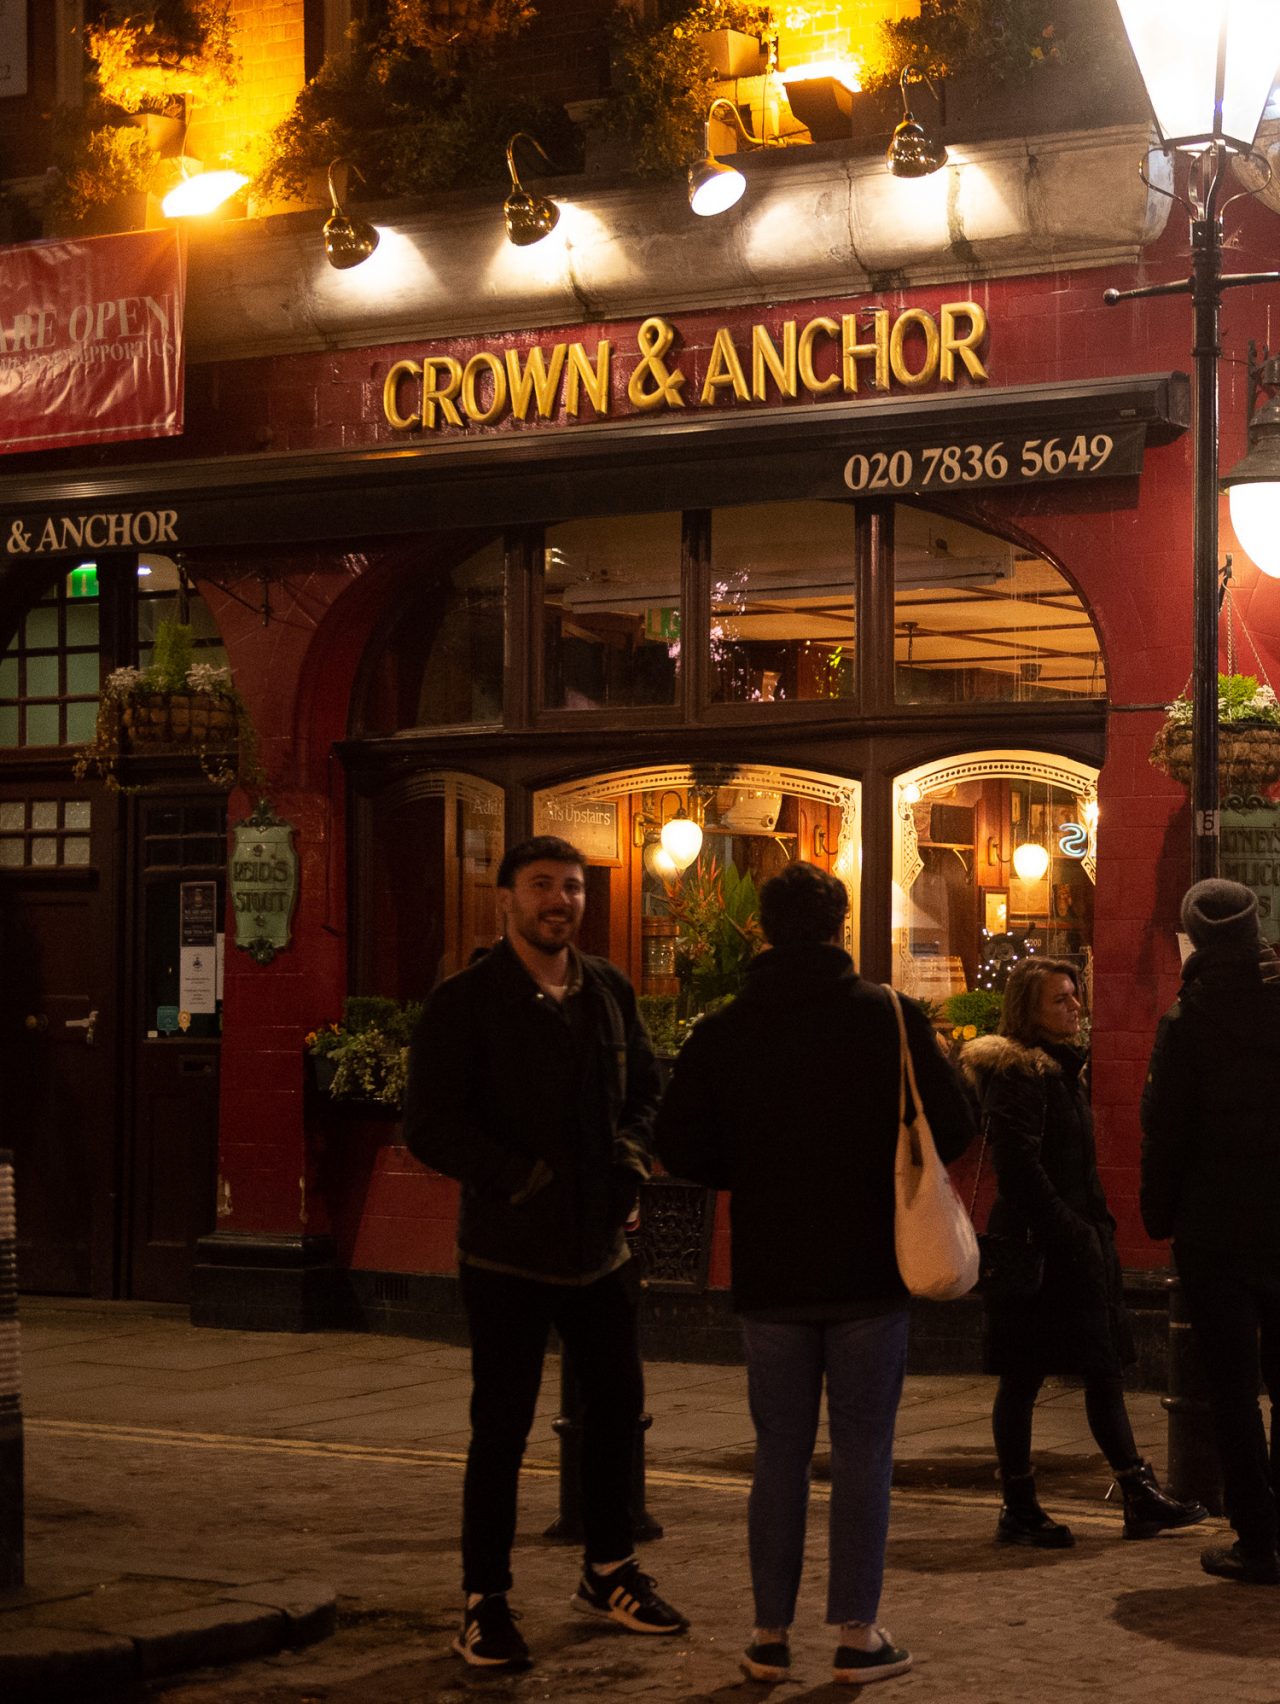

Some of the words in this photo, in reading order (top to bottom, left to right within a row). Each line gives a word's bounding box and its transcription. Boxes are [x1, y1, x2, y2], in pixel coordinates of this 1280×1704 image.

[0, 308, 57, 353] RE
[69, 294, 171, 343] OPEN
[383, 340, 611, 431] CROWN
[627, 316, 687, 409] &
[699, 301, 989, 405] ANCHOR
[844, 450, 913, 490] 020
[921, 442, 1008, 485] 7836
[1020, 434, 1114, 477] 5649
[6, 520, 32, 553] &
[35, 510, 179, 552] ANCHOR
[565, 805, 611, 828] Upstairs
[234, 854, 288, 882] REID'S
